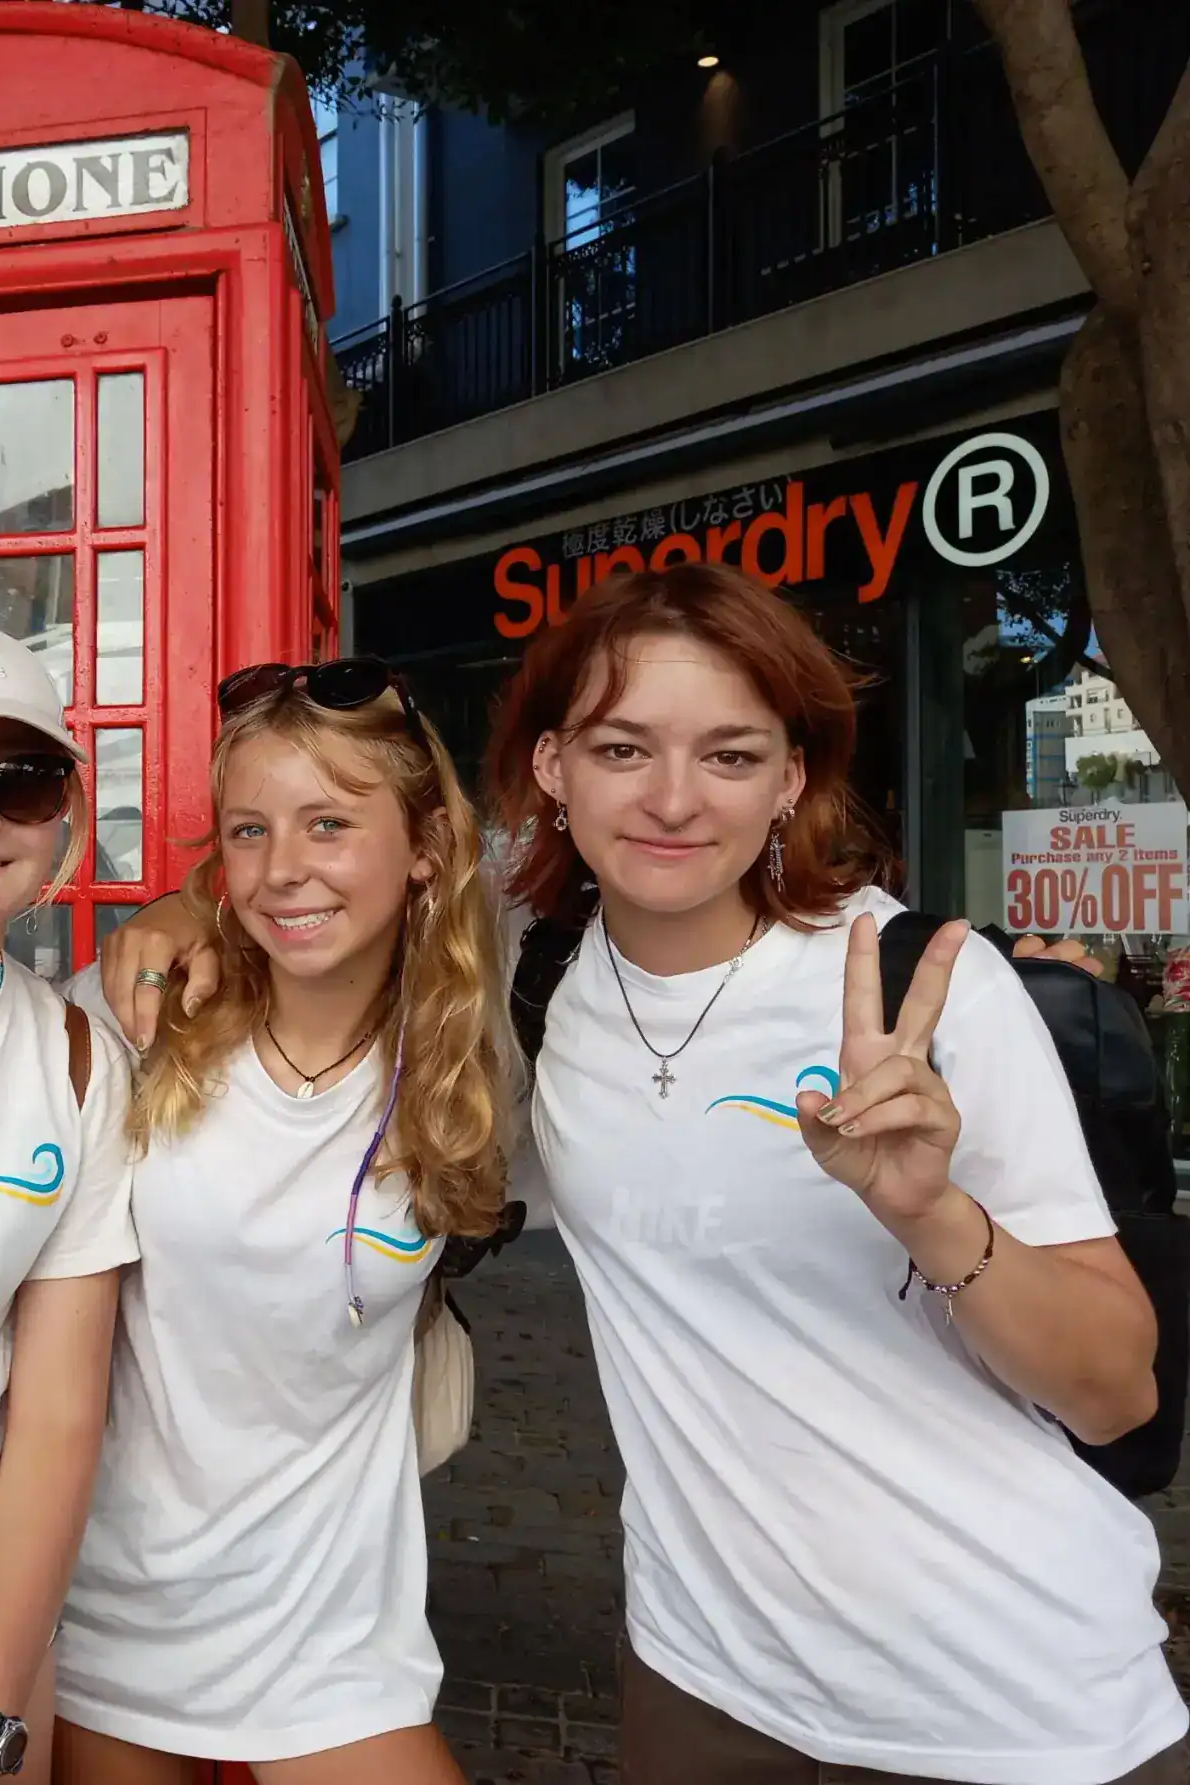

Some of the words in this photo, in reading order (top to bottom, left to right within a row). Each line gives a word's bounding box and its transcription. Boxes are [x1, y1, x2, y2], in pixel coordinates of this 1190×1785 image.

[1050, 823, 1136, 851] SALE
[1011, 852, 1081, 864] Purchase
[1086, 852, 1113, 864] any
[1118, 850, 1128, 861] 2
